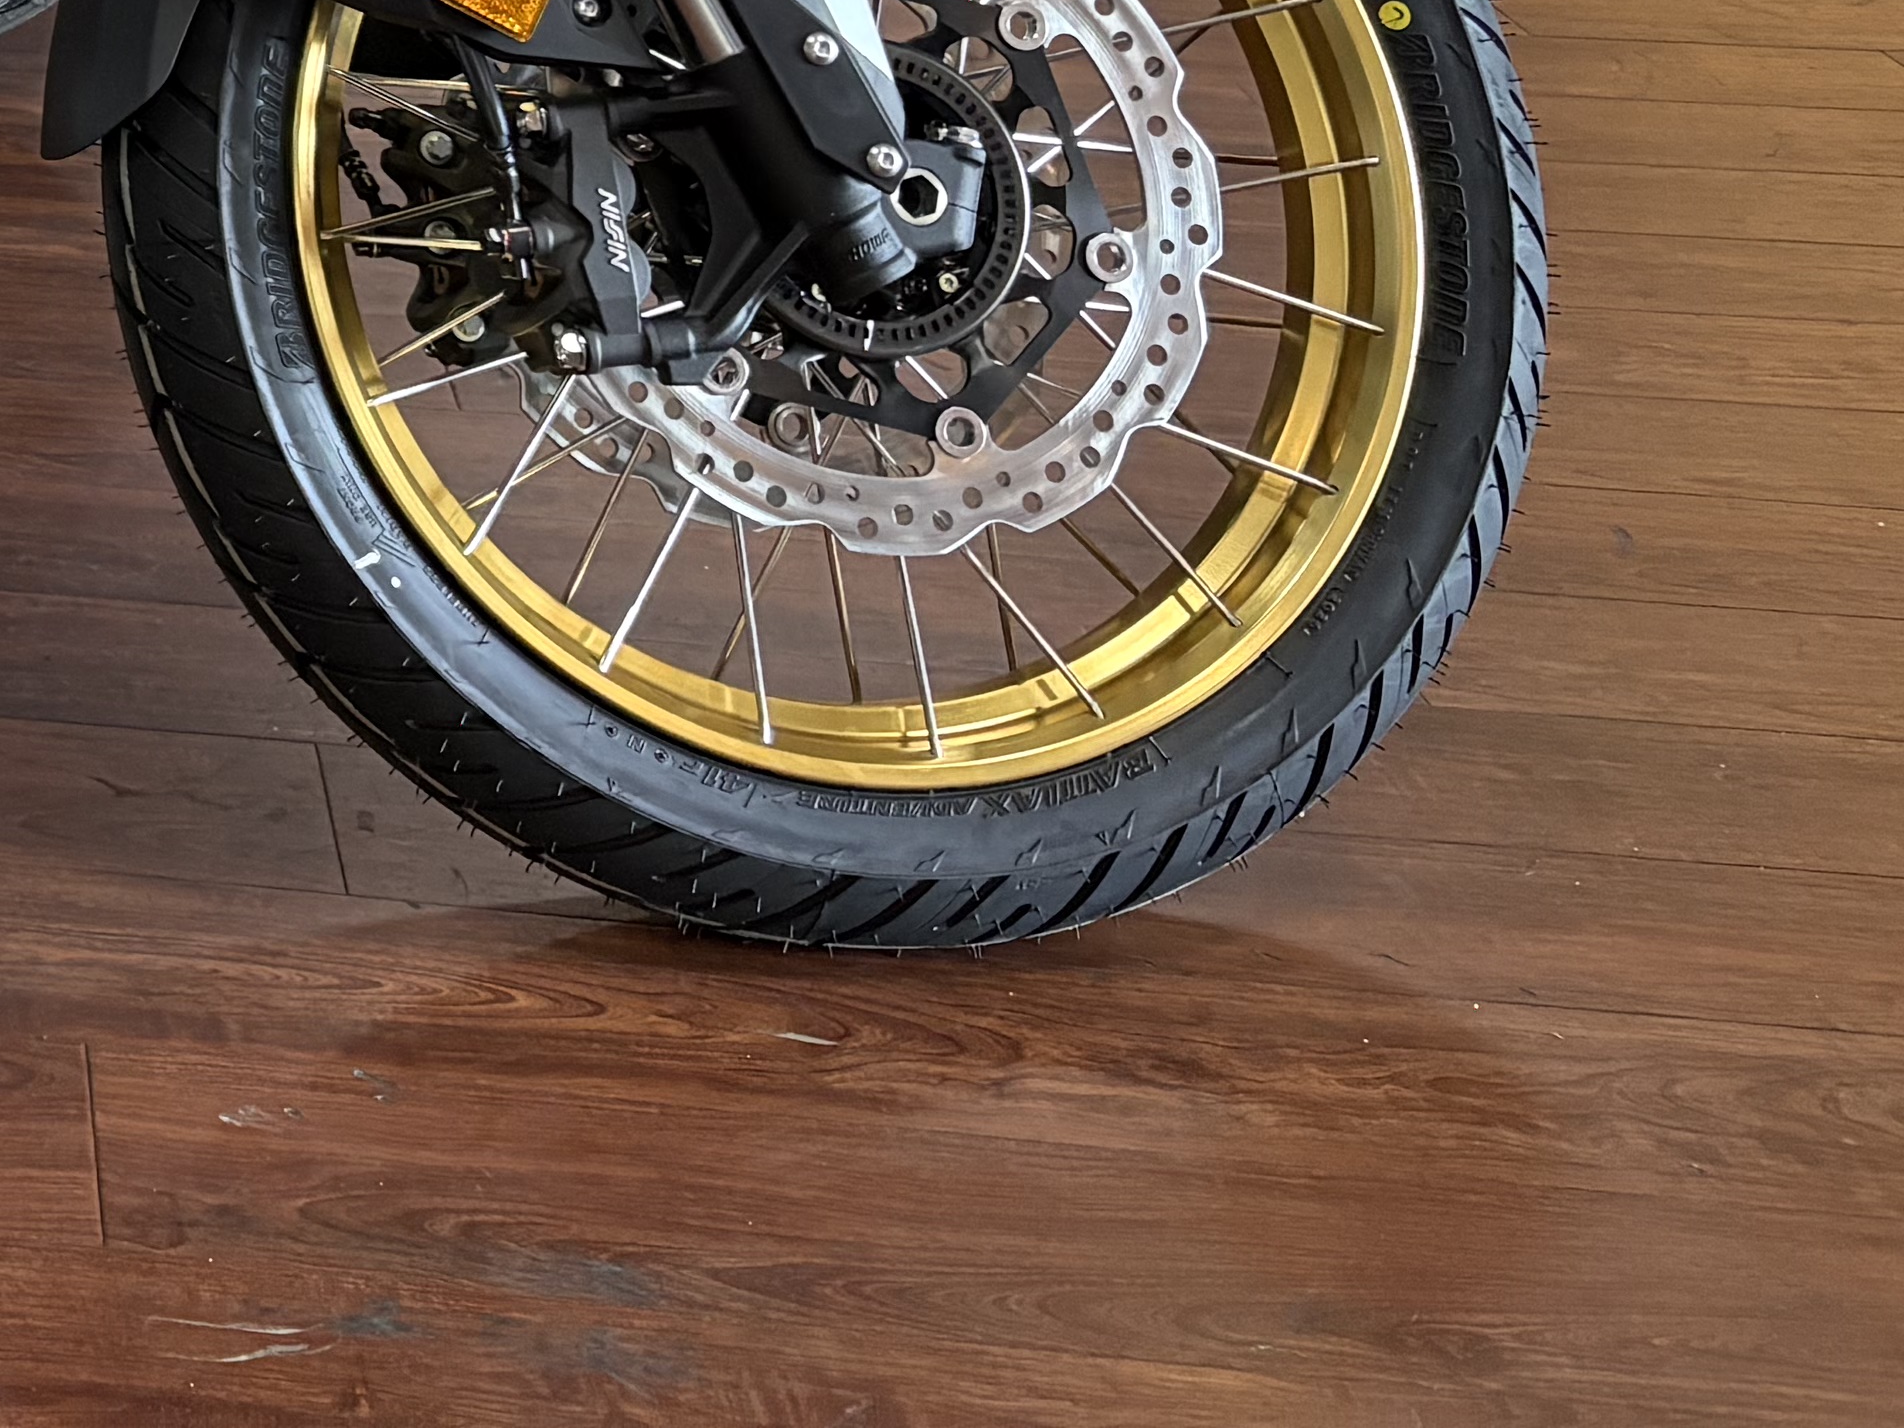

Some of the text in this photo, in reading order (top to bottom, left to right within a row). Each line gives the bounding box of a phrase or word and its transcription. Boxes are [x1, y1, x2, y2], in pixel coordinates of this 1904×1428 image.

[252, 37, 318, 370] BRIDGESTONE
[597, 187, 630, 273] NISSIN
[1390, 33, 1471, 358] BRIDGESTONE
[797, 746, 1157, 819] BATTLAX ADVENTURE
